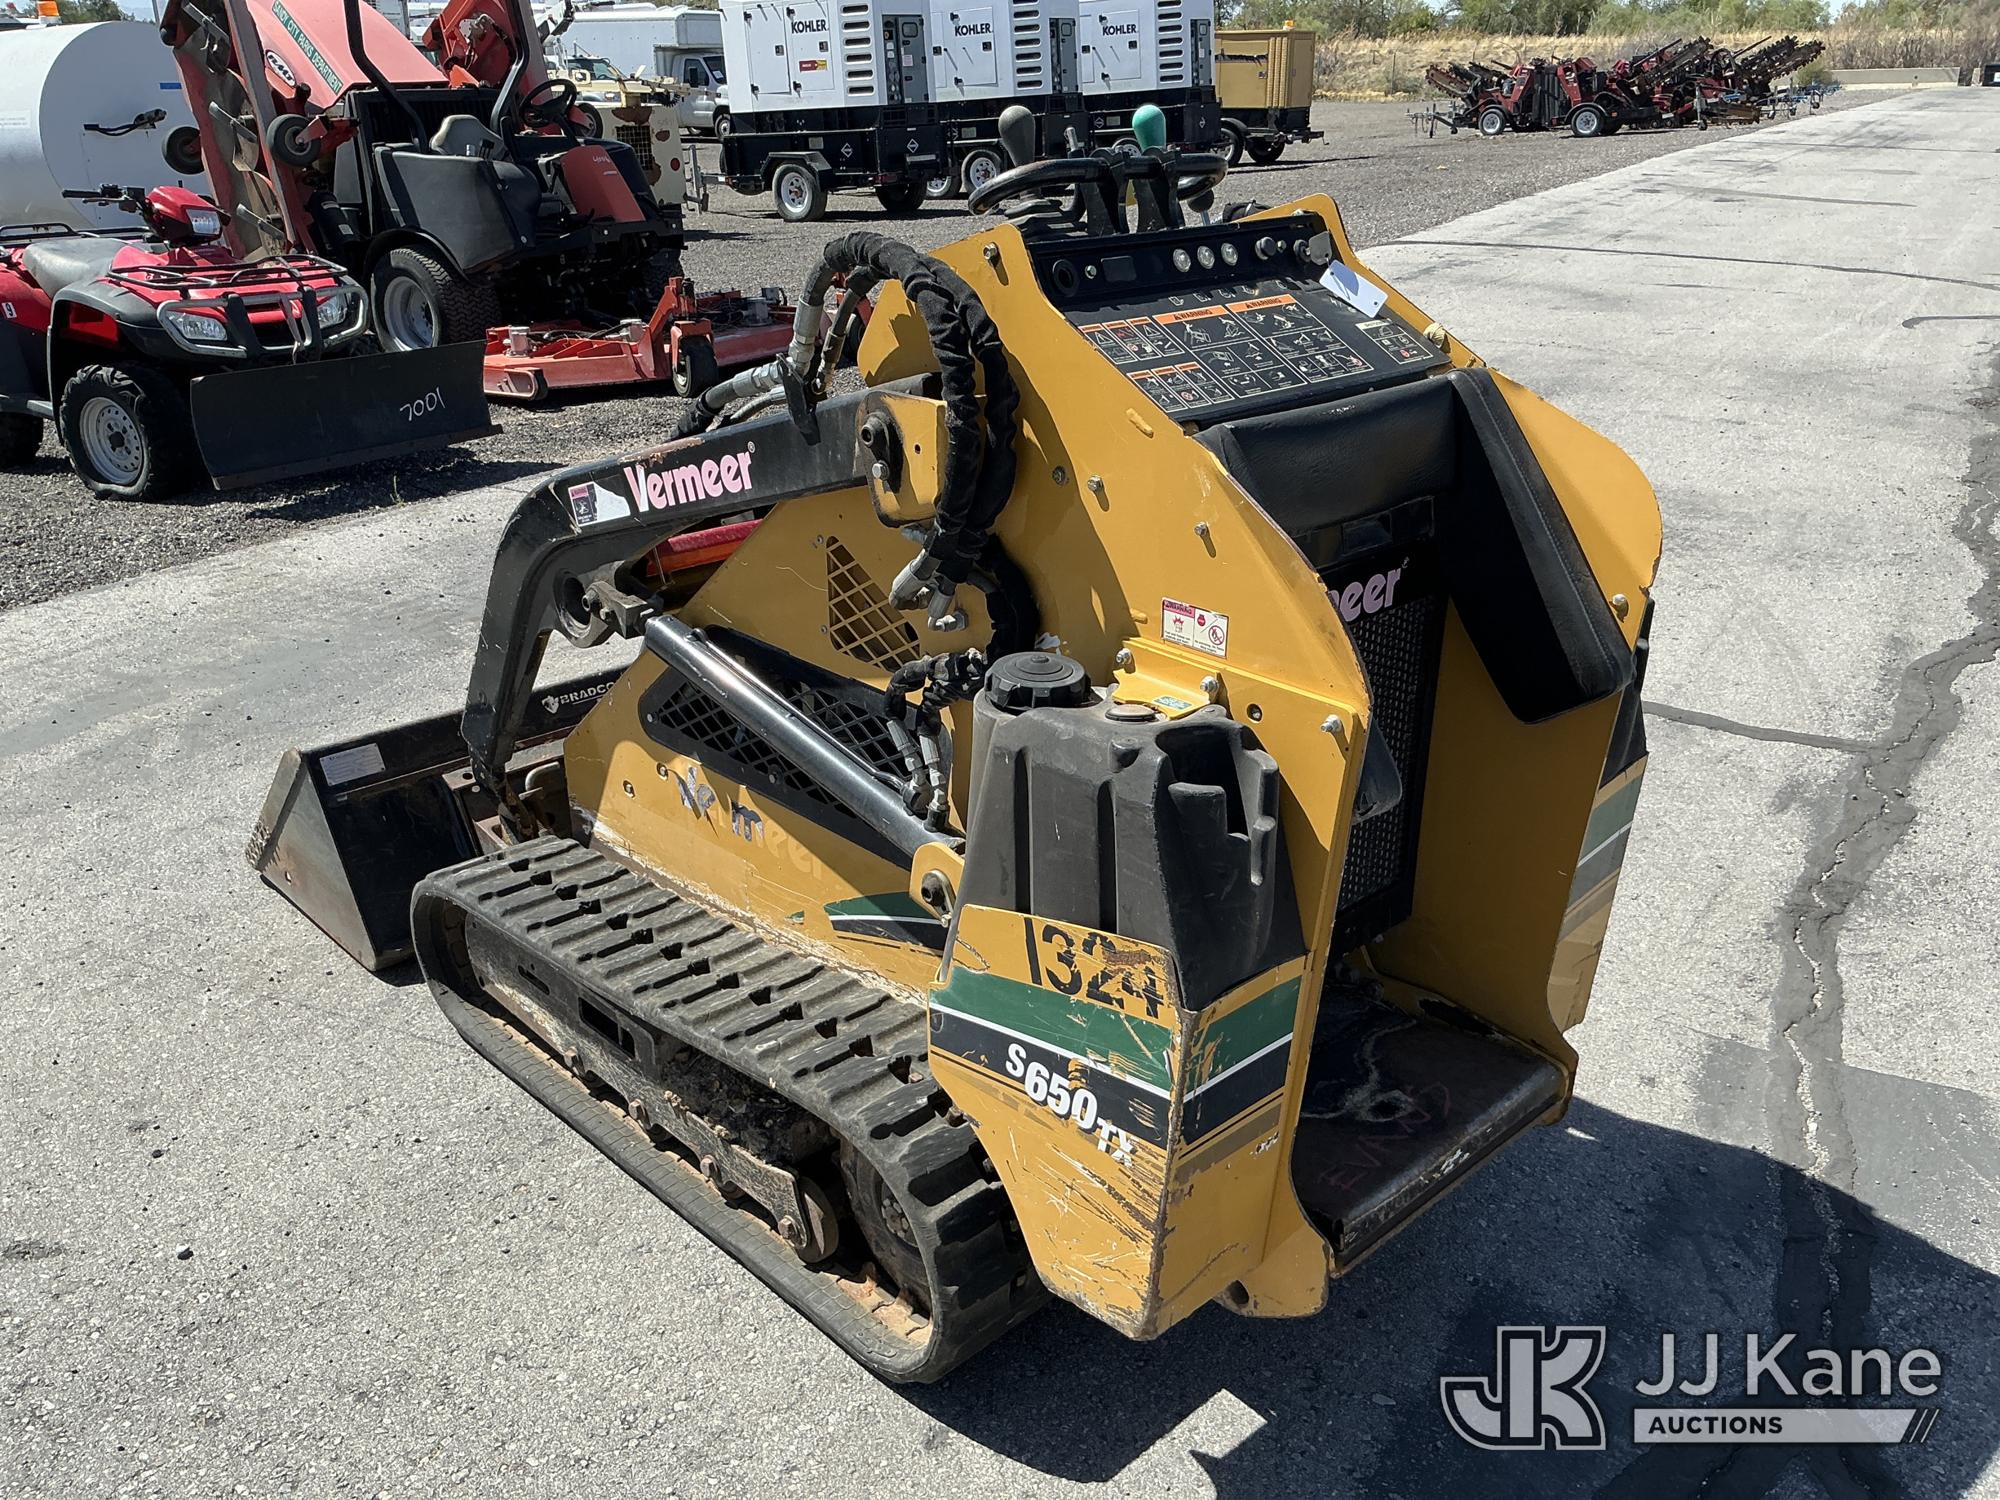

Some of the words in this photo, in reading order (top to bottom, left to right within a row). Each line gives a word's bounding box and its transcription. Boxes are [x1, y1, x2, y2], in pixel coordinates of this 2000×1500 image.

[791, 19, 827, 34] KOHLER
[954, 22, 992, 37] KOHLER
[1102, 24, 1137, 36] KOHLER
[287, 20, 300, 38] CITY
[297, 34, 314, 57] PARKS
[311, 52, 342, 94] DEPARTMENT
[400, 386, 446, 422] 7001
[623, 452, 753, 513] Vermeer
